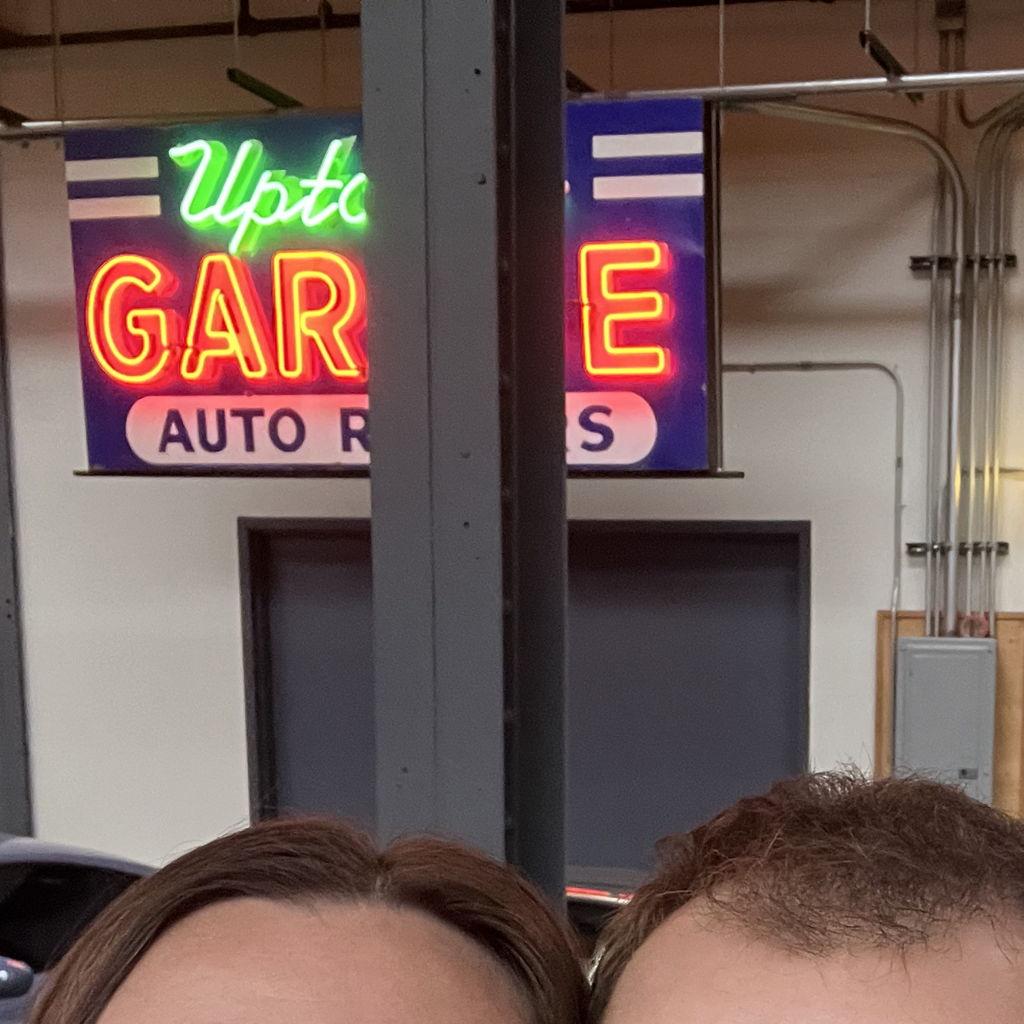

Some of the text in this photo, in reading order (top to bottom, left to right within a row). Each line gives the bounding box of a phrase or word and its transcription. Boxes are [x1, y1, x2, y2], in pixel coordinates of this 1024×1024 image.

[168, 134, 369, 257] Upto
[86, 239, 674, 384] GARE
[158, 407, 306, 454] AUTO
